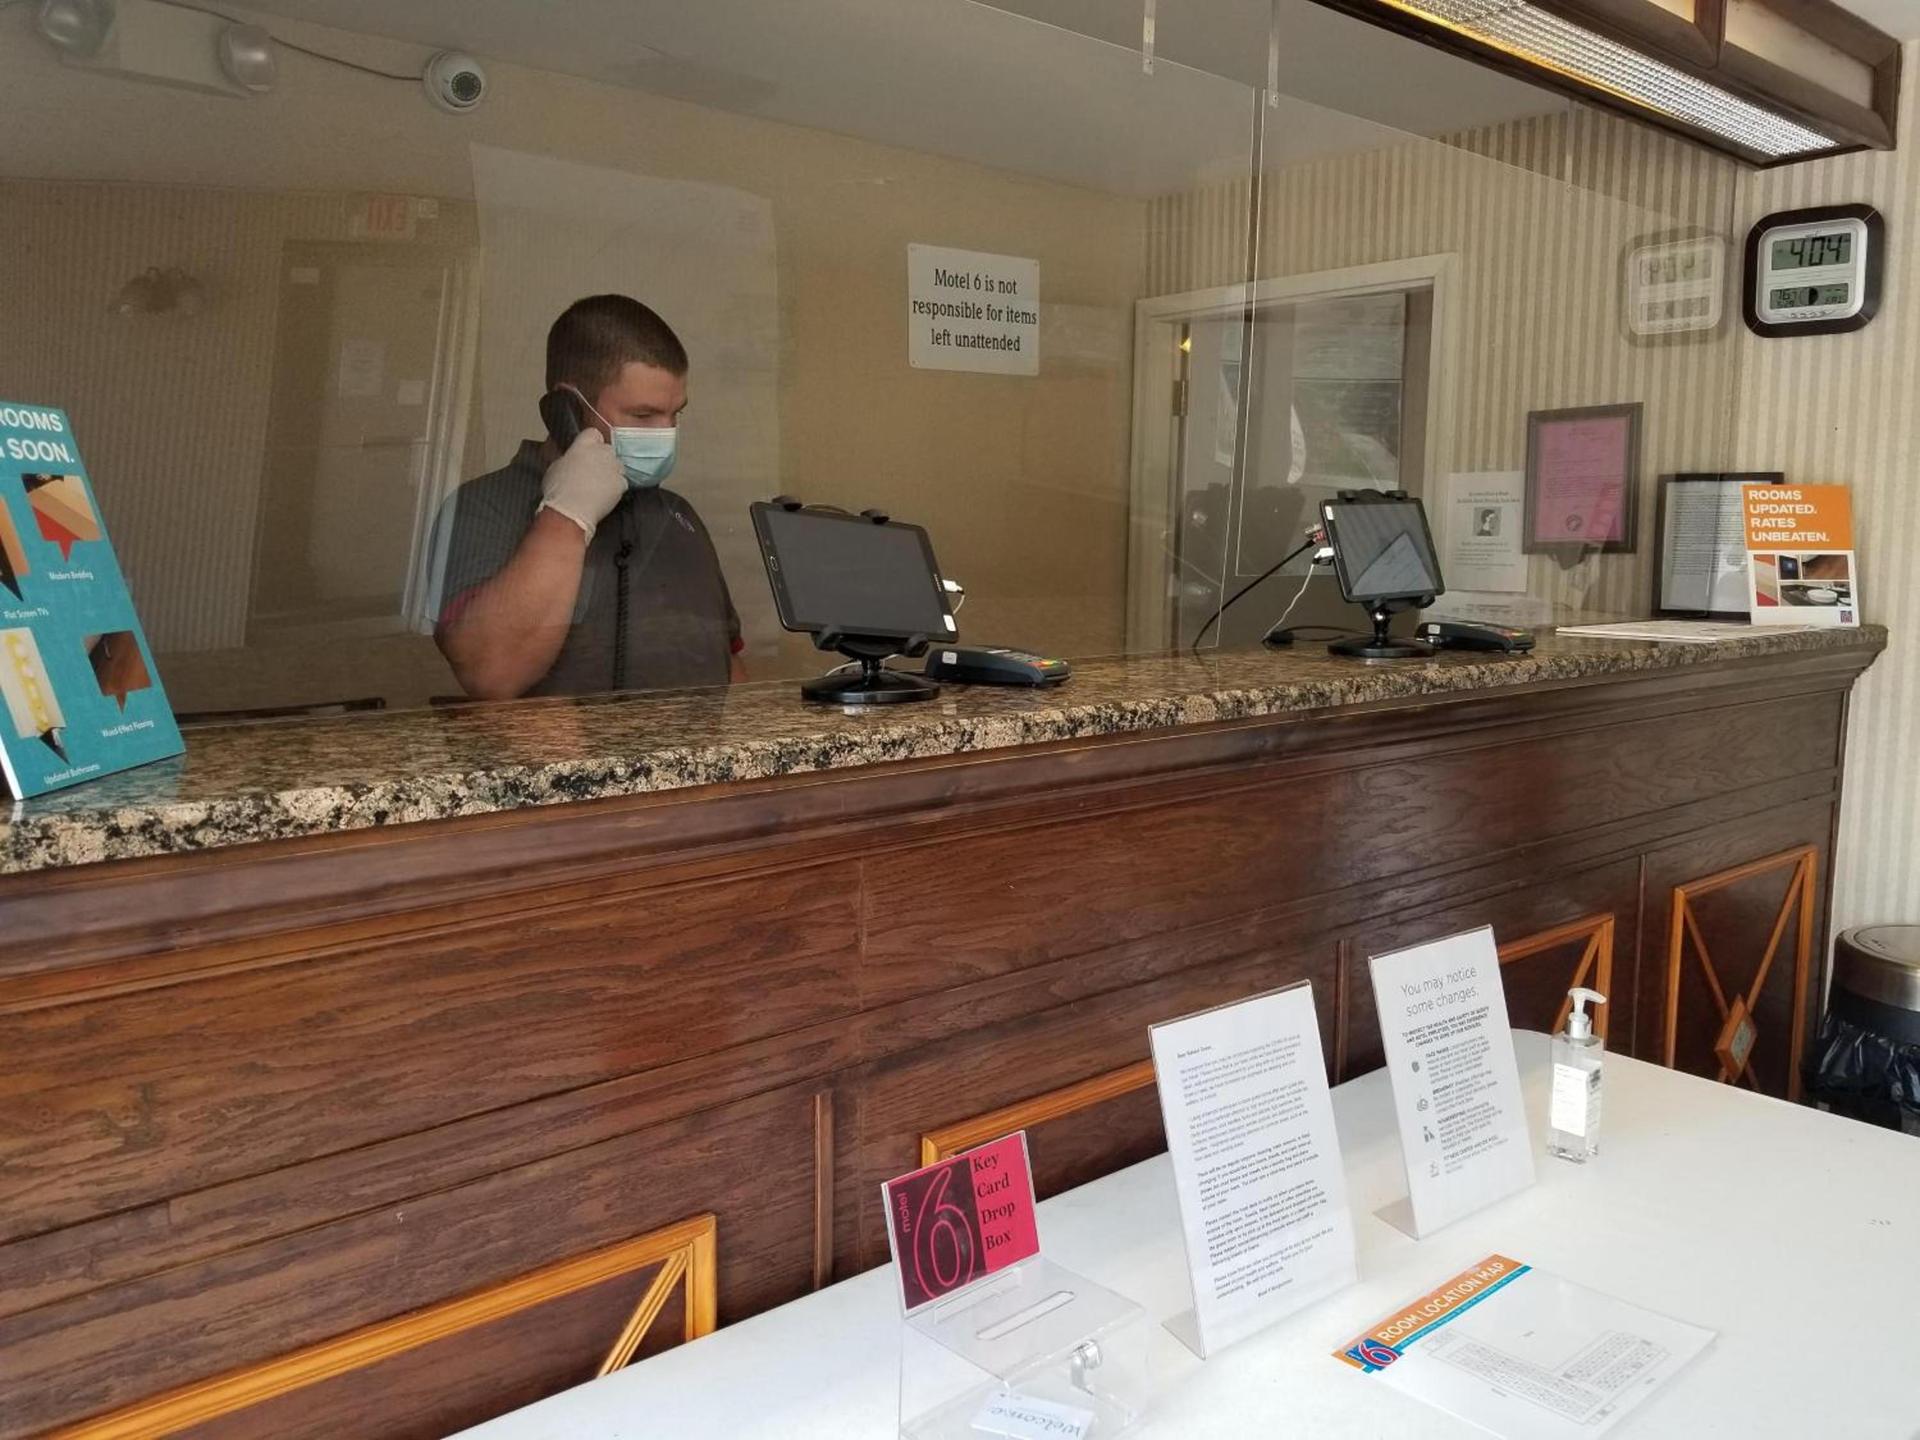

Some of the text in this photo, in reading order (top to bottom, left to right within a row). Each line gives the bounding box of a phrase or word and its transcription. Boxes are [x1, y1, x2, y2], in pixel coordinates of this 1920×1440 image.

[934, 268, 1018, 295] Motel 6 is not
[912, 300, 1037, 325] responsible for items
[931, 328, 1021, 352] left unattended
[7, 438, 75, 463] SOON.
[1748, 490, 1802, 500] ROOMS
[1749, 503, 1818, 514] UPDATED.
[1750, 517, 1797, 528] RATES
[1752, 531, 1830, 542] UNBEATEN.
[1401, 967, 1477, 997] You may notice
[1406, 1000, 1434, 1017] some
[973, 1152, 1001, 1173] Key
[977, 1172, 1010, 1198] Card
[981, 1202, 1016, 1225] Drop
[914, 1166, 974, 1299] 6
[985, 1230, 1013, 1250] Box
[1376, 1262, 1506, 1342] ROOM LOCATION MAP
[1358, 1342, 1400, 1367] 6
